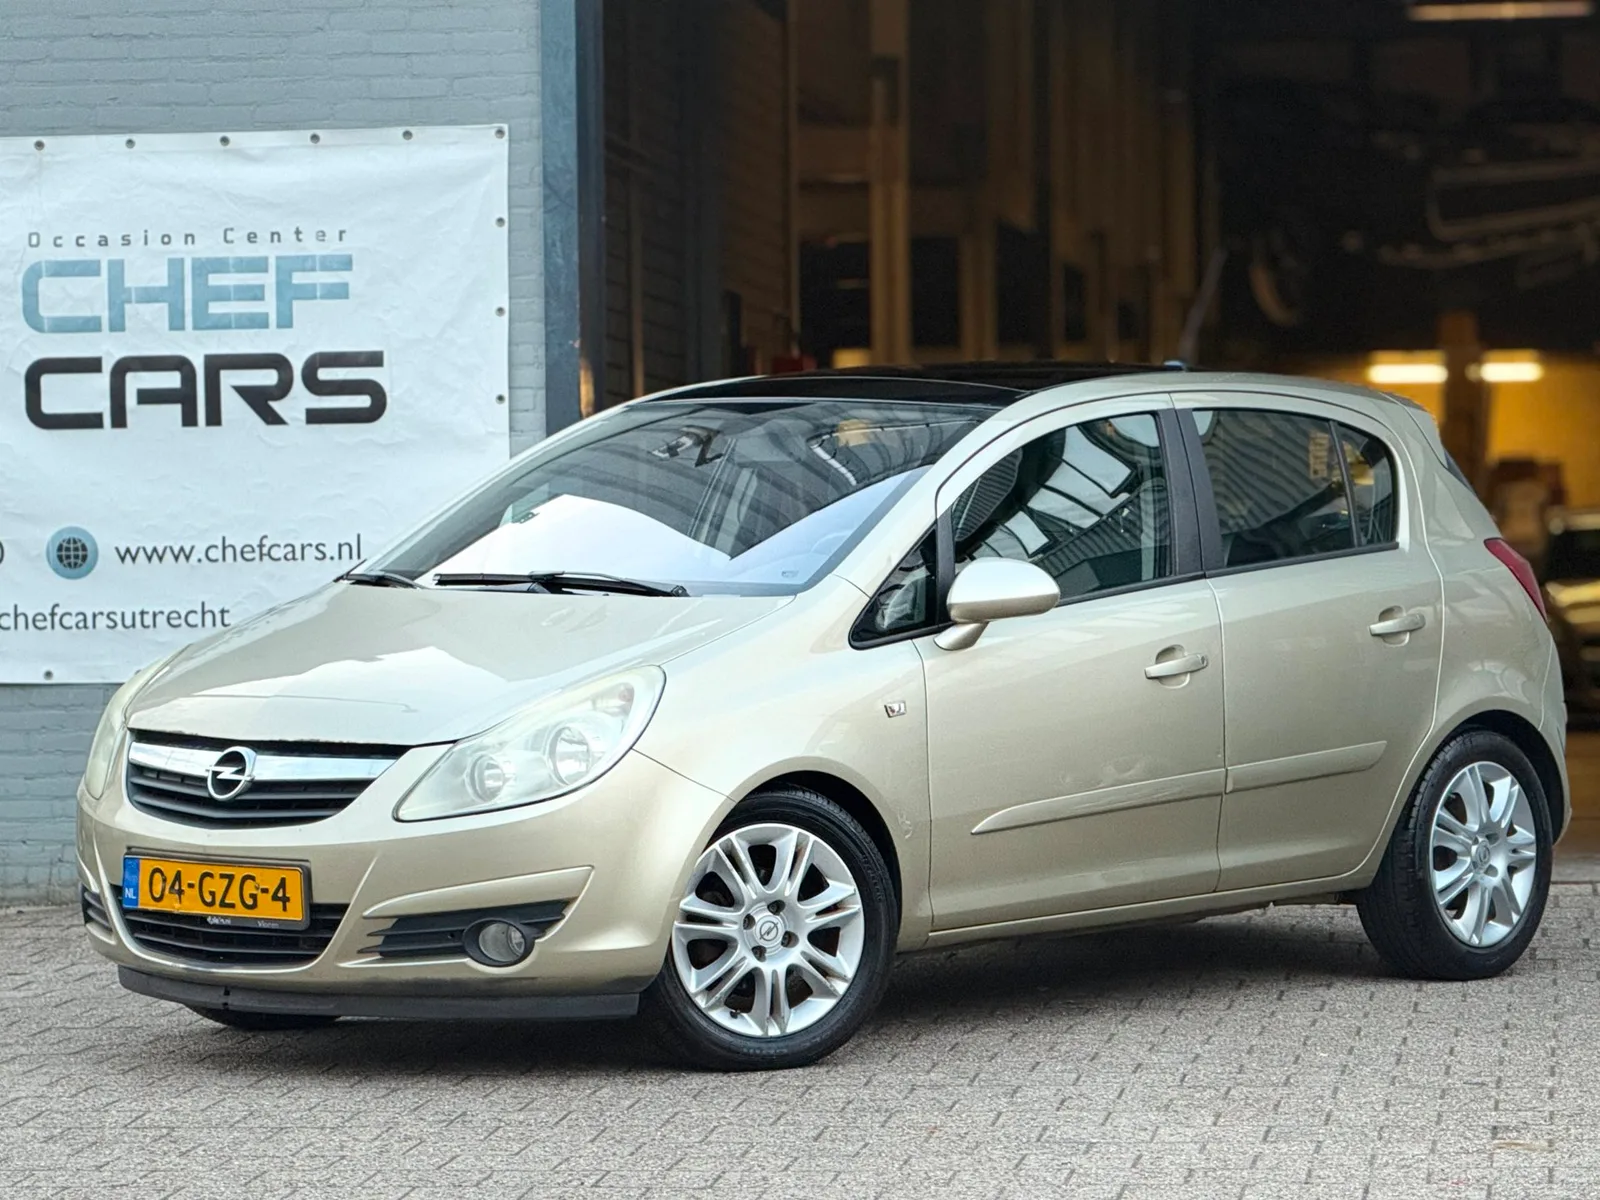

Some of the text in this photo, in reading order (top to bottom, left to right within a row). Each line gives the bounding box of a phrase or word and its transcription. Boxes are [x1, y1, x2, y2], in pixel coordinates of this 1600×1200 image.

[28, 226, 347, 248] Occasion Center
[22, 254, 353, 334] CHEF
[25, 351, 387, 430] CARS
[114, 533, 362, 564] www.chefcars.nl
[0, 601, 231, 631] chefcarsutrecht
[124, 887, 137, 899] NL
[148, 867, 291, 912] 04-GZG-4
